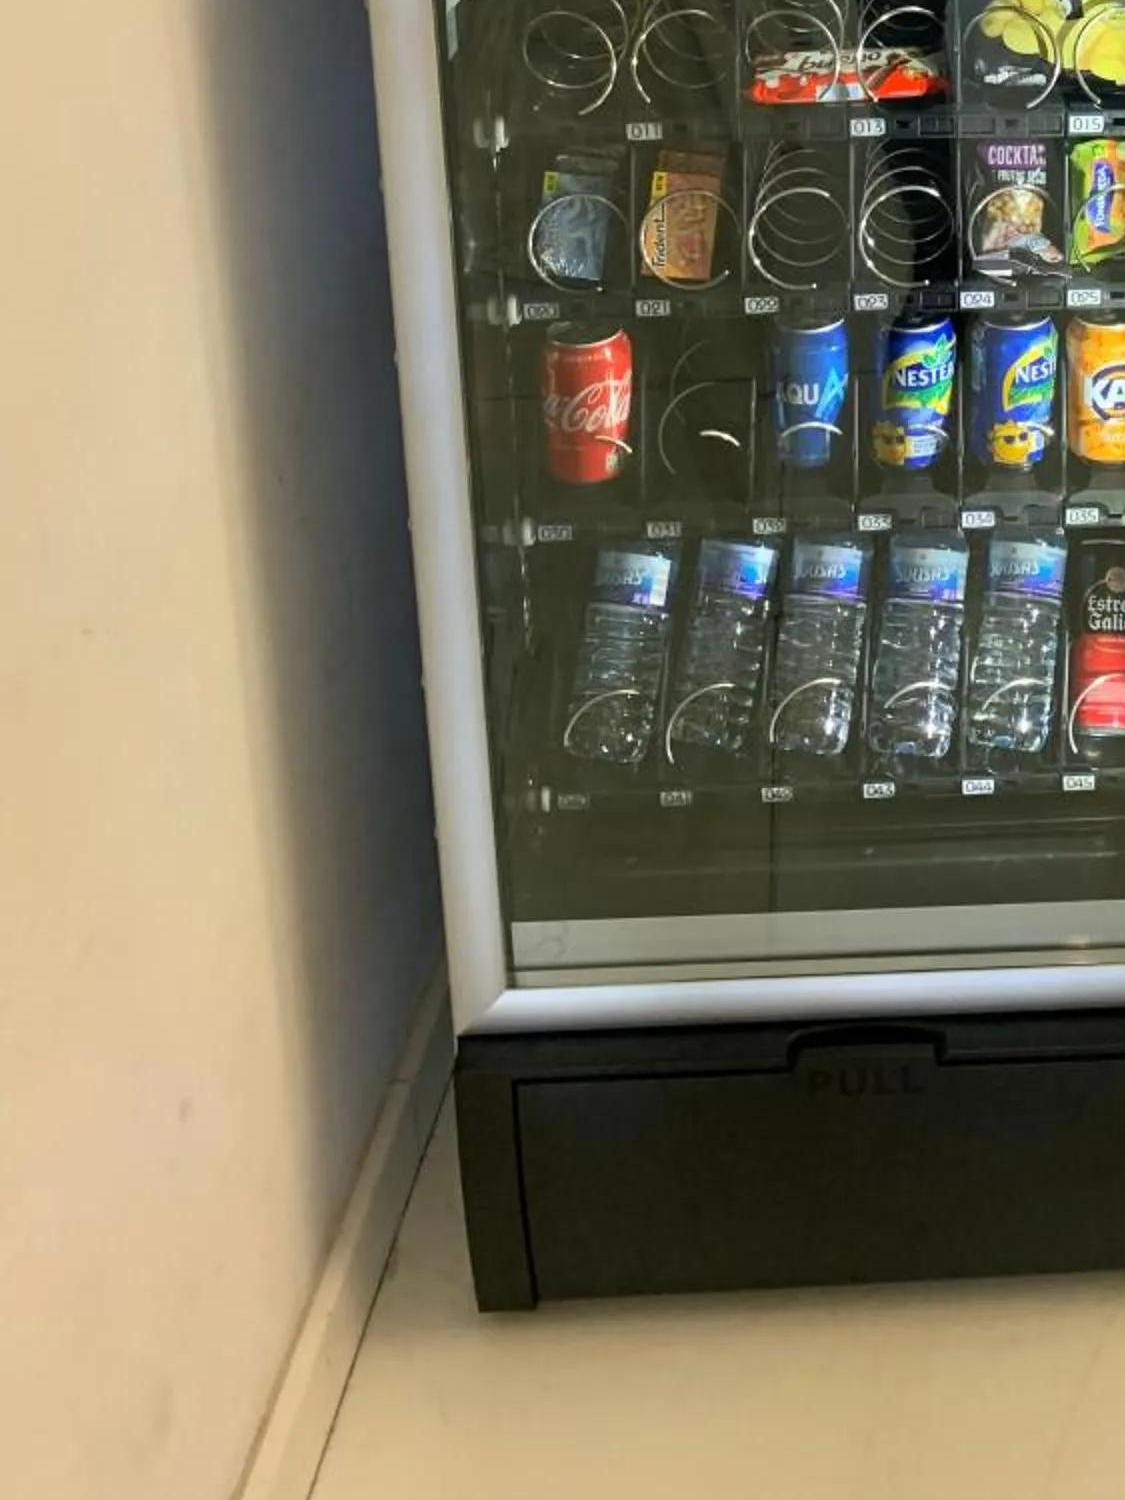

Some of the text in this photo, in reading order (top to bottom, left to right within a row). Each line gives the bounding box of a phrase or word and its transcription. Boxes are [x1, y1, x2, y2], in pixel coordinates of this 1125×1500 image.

[853, 120, 883, 134] 013
[1072, 116, 1101, 131] 015
[988, 144, 1047, 165] COCKTA
[651, 202, 666, 268] Trident
[806, 1065, 924, 1098] PULL
